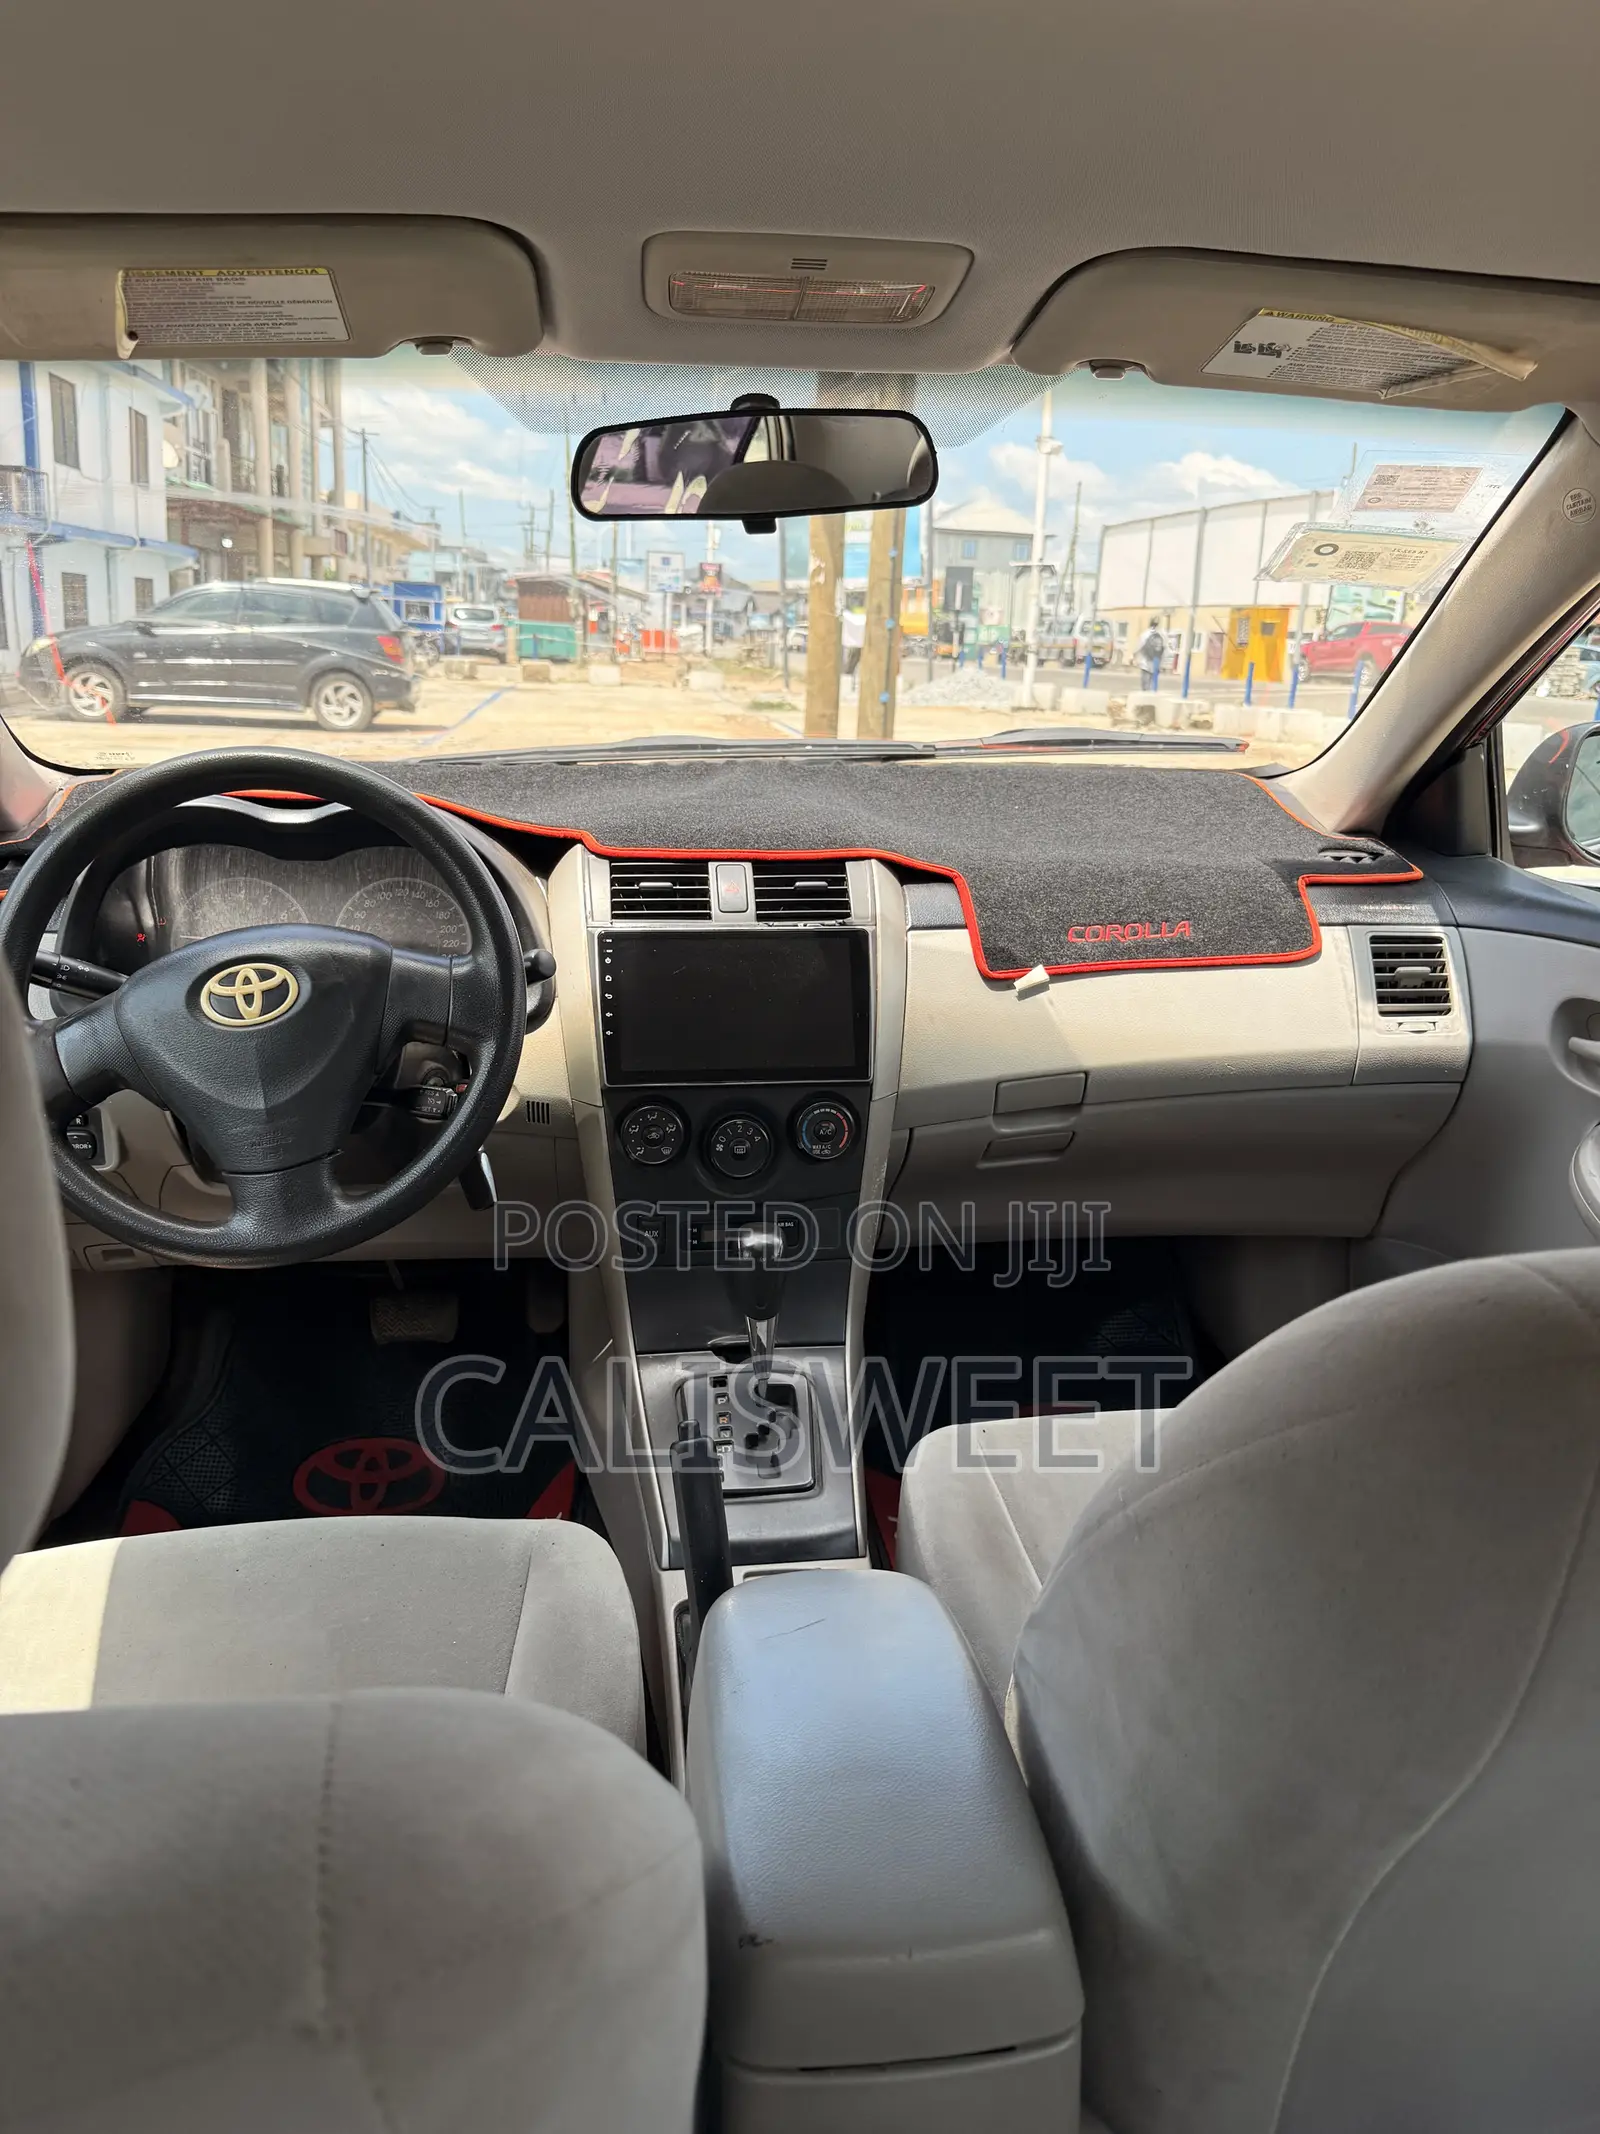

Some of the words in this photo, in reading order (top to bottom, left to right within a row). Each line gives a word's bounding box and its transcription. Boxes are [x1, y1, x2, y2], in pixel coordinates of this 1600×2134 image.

[217, 268, 320, 276] ADVERTENCIA
[1276, 312, 1335, 322] WARNING
[377, 891, 392, 901] 100
[395, 888, 409, 897] 120
[412, 890, 426, 900] 140
[355, 911, 366, 919] 60
[440, 925, 458, 934] 200
[1067, 920, 1190, 942] COROLLA
[443, 939, 460, 948] 220
[75, 1117, 82, 1125] R
[746, 1127, 753, 1135] 3
